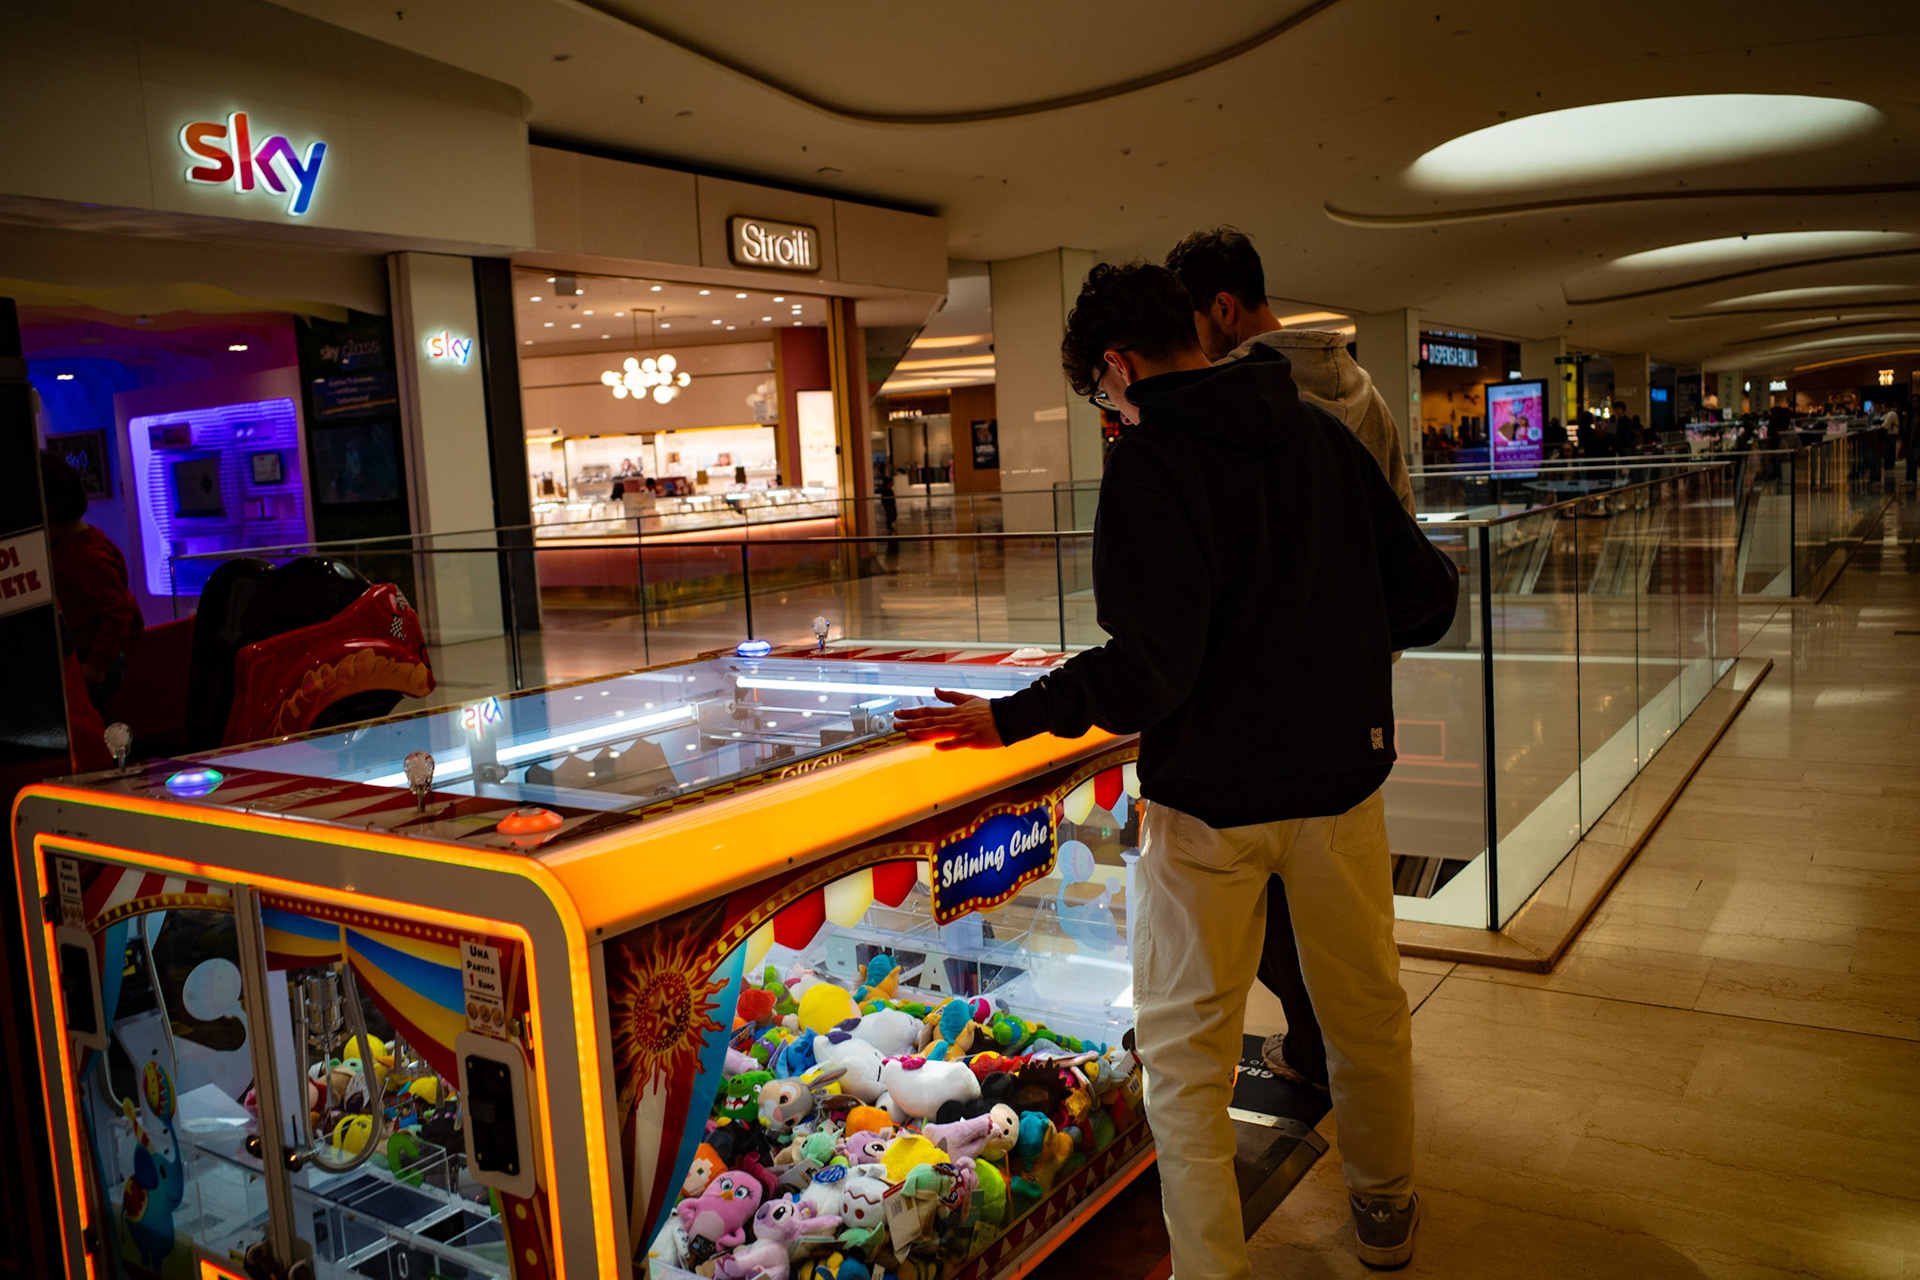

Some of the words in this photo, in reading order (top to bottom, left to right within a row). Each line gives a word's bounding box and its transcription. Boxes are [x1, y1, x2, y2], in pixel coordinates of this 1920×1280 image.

[180, 112, 328, 217] sky
[742, 222, 810, 266] Stroili
[427, 331, 473, 366] sky
[942, 845, 1005, 888] Shining
[1009, 820, 1048, 858] Cube
